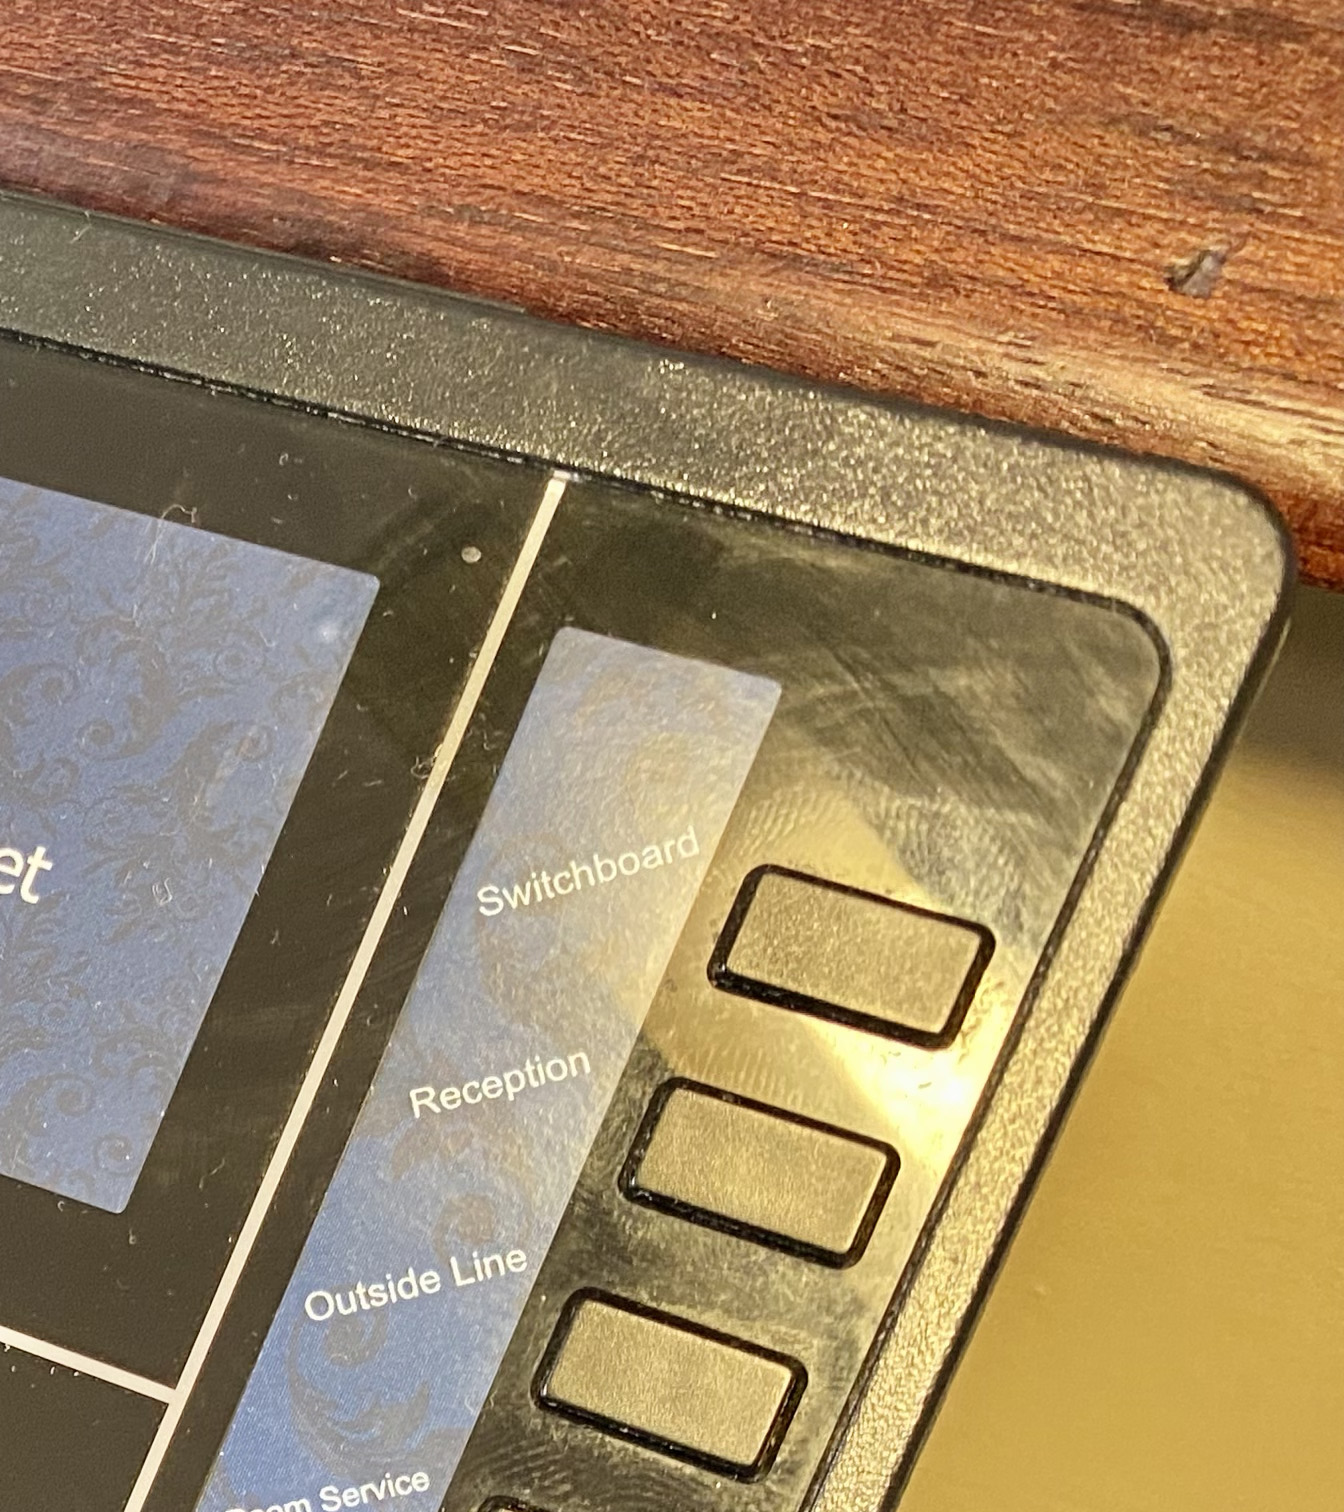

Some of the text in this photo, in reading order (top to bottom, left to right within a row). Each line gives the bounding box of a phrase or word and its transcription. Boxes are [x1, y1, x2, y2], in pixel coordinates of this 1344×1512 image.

[478, 826, 701, 918] Switchboard
[410, 1050, 592, 1119] Reception
[304, 1246, 528, 1322] Outside Line
